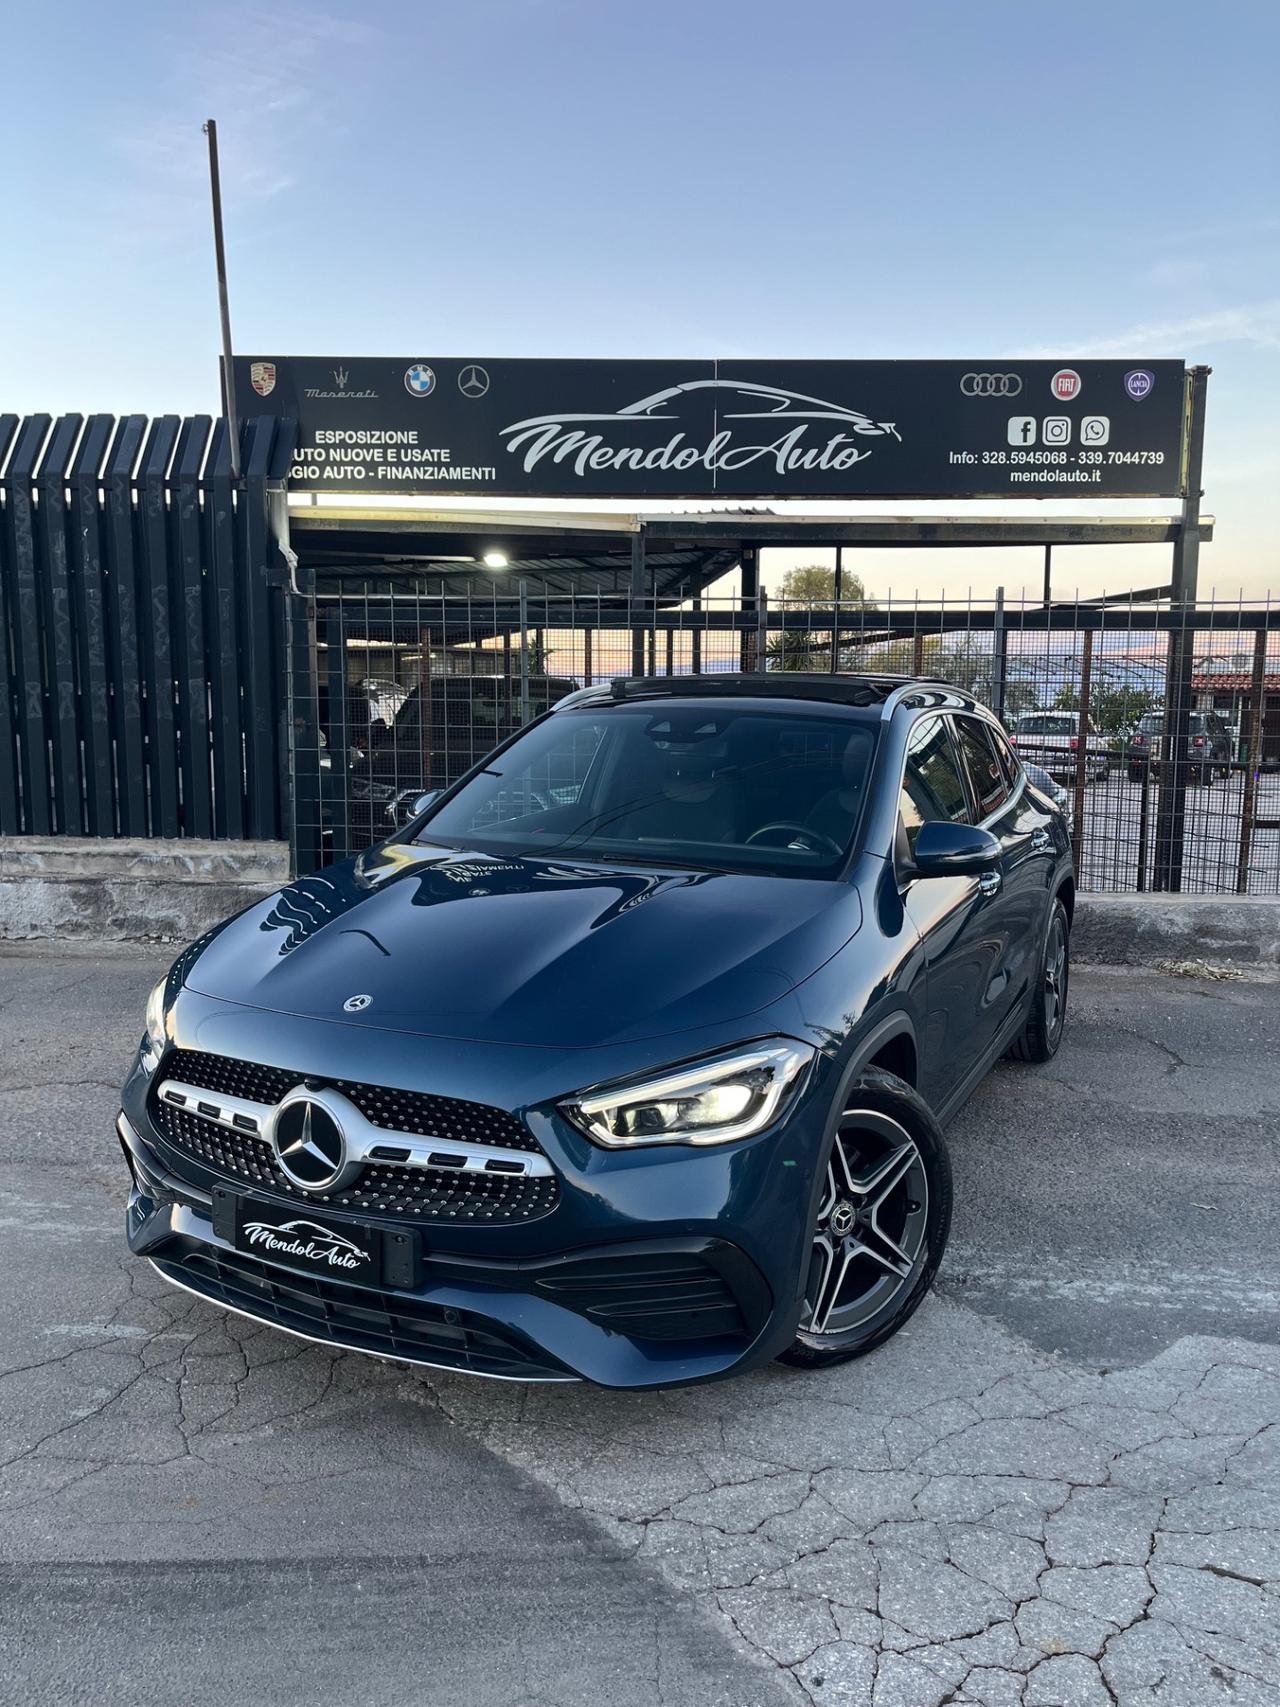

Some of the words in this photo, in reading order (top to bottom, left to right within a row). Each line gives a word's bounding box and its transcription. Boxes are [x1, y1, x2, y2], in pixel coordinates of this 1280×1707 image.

[1058, 378, 1075, 392] FIAT
[303, 388, 379, 398] Maserati
[315, 430, 418, 444] ESPOSIZIONE
[291, 448, 326, 462] UTO
[329, 448, 383, 462] NUOVE
[387, 448, 397, 462] E
[401, 448, 450, 462] USATE
[949, 451, 979, 464] Info:
[982, 451, 1067, 464] 328.5945068
[1078, 451, 1164, 464] 339.7044739
[288, 465, 320, 479] GIO
[323, 465, 365, 480] AUTO
[378, 466, 496, 481] FINANZIAMENTI
[1010, 469, 1101, 482] mendolauto.it
